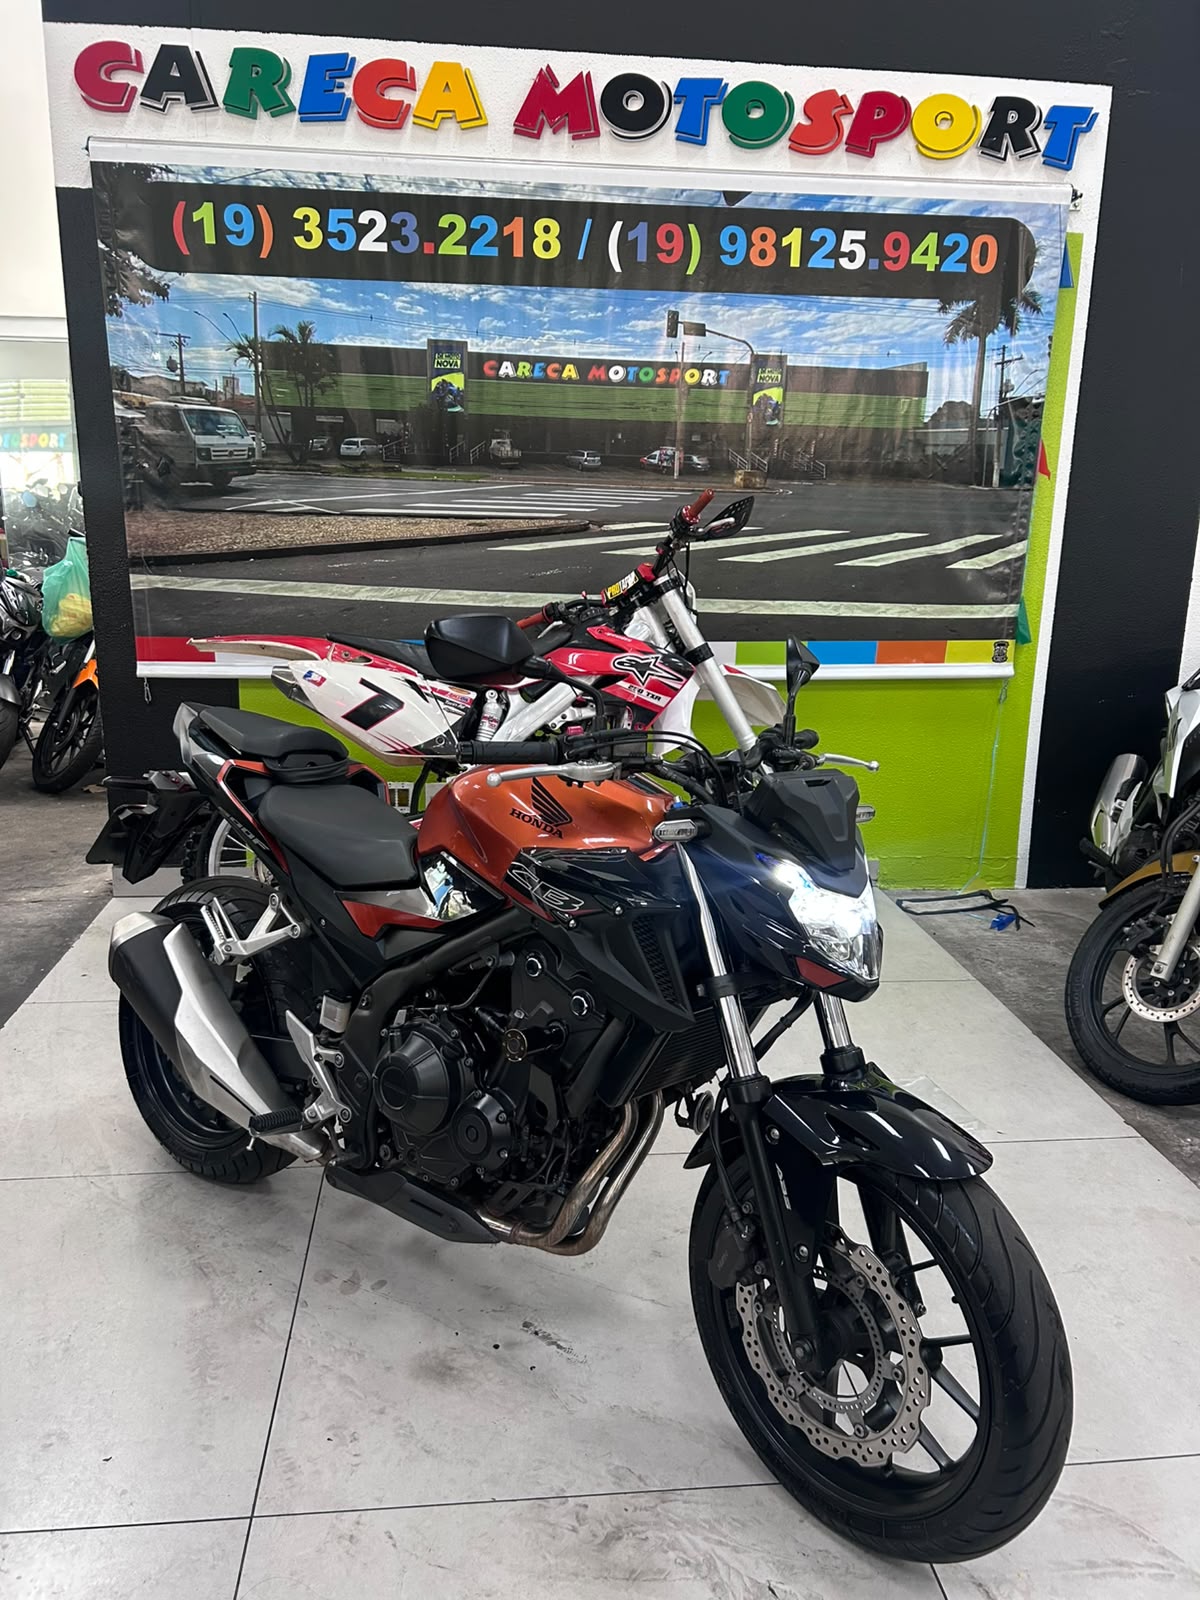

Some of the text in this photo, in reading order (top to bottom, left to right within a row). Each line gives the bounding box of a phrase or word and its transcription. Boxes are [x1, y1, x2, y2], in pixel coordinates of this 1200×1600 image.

[74, 40, 1097, 171] CARECA MOTOSPORT
[172, 200, 999, 275] (19) 3523.2218 / (19) 98125.9420
[435, 359, 460, 369] NOVA
[482, 359, 730, 387] CARECA MOTOSPORT
[341, 677, 405, 731] 7
[509, 807, 564, 839] HONDA
[507, 861, 585, 912] CB
